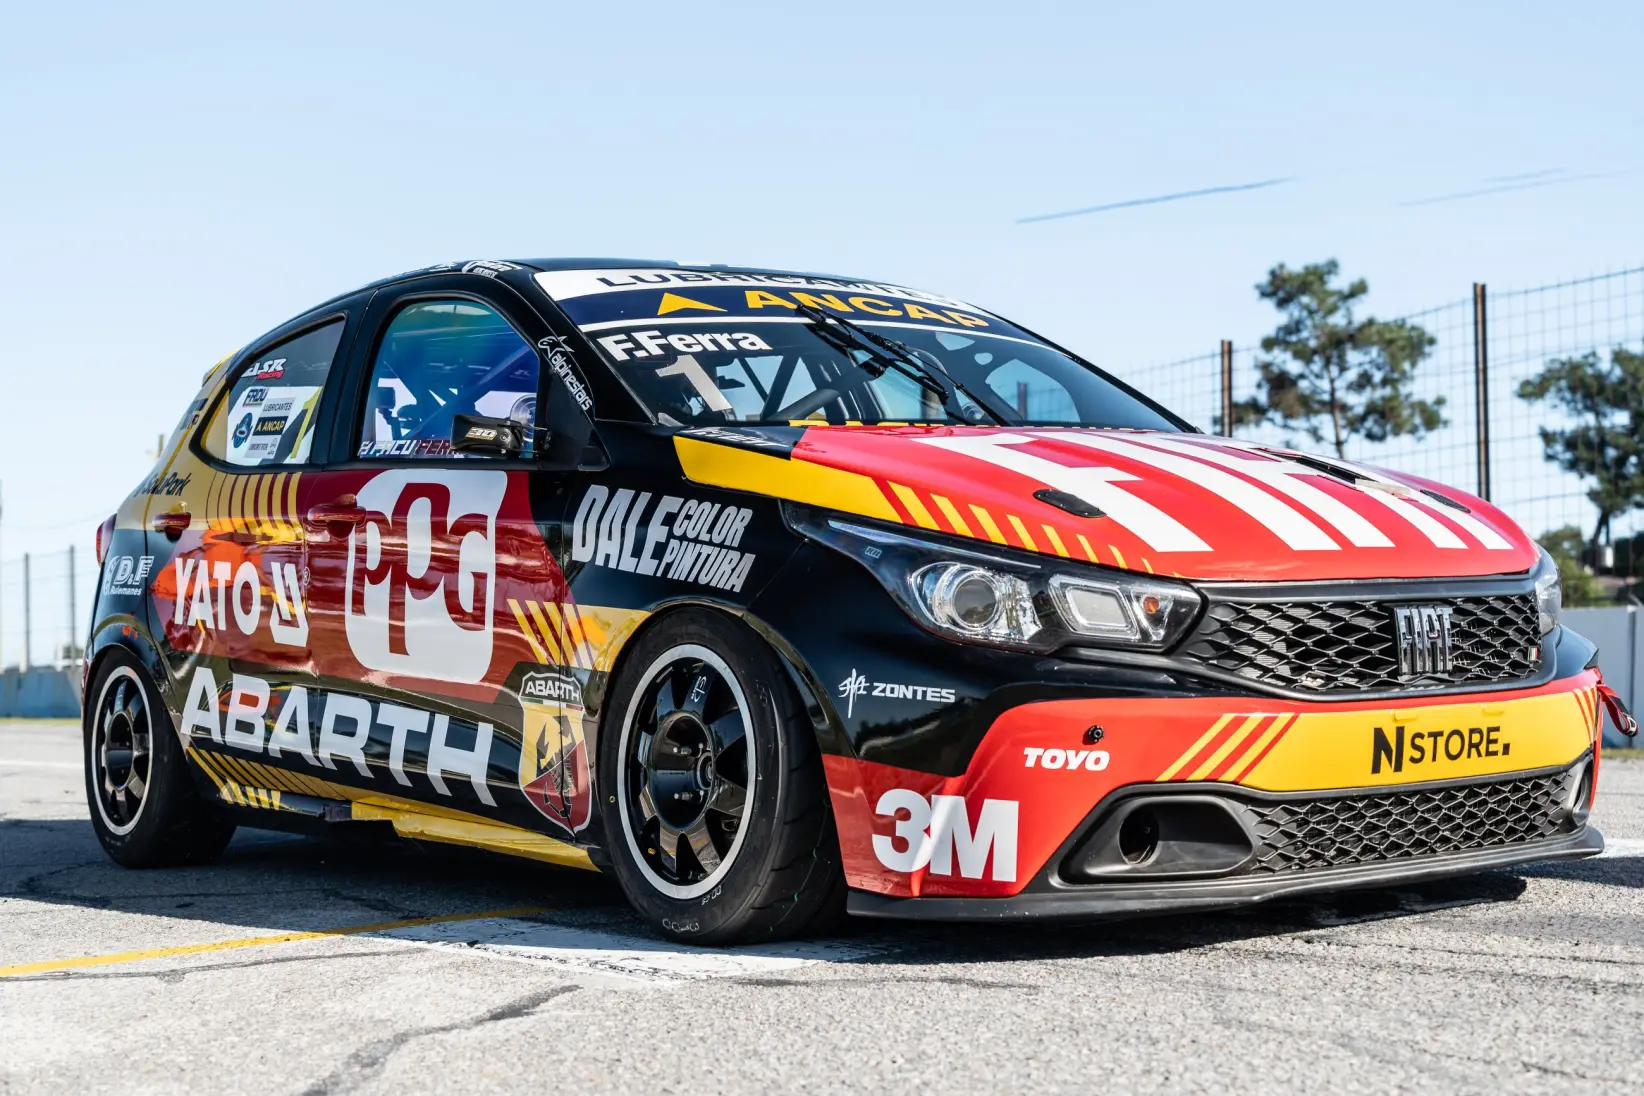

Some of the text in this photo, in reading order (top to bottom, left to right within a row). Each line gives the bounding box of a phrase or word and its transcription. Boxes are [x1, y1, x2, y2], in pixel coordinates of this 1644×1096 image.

[596, 272, 958, 306] LUBRICANTE
[745, 290, 989, 328] ANCAP
[597, 330, 772, 361] F.Ferra
[551, 353, 593, 411] alpinestars
[655, 354, 733, 412] 1
[262, 420, 286, 431] ANCAP
[572, 484, 684, 577] DALE
[672, 499, 753, 547] COLOR
[656, 539, 756, 593] PINTURA
[174, 557, 261, 636] YATO
[525, 679, 580, 702] ABARTH
[872, 682, 956, 703] ZONTES
[180, 666, 498, 808] ABARTH
[1023, 747, 1110, 771] TOYO
[872, 788, 1019, 883] 3M
